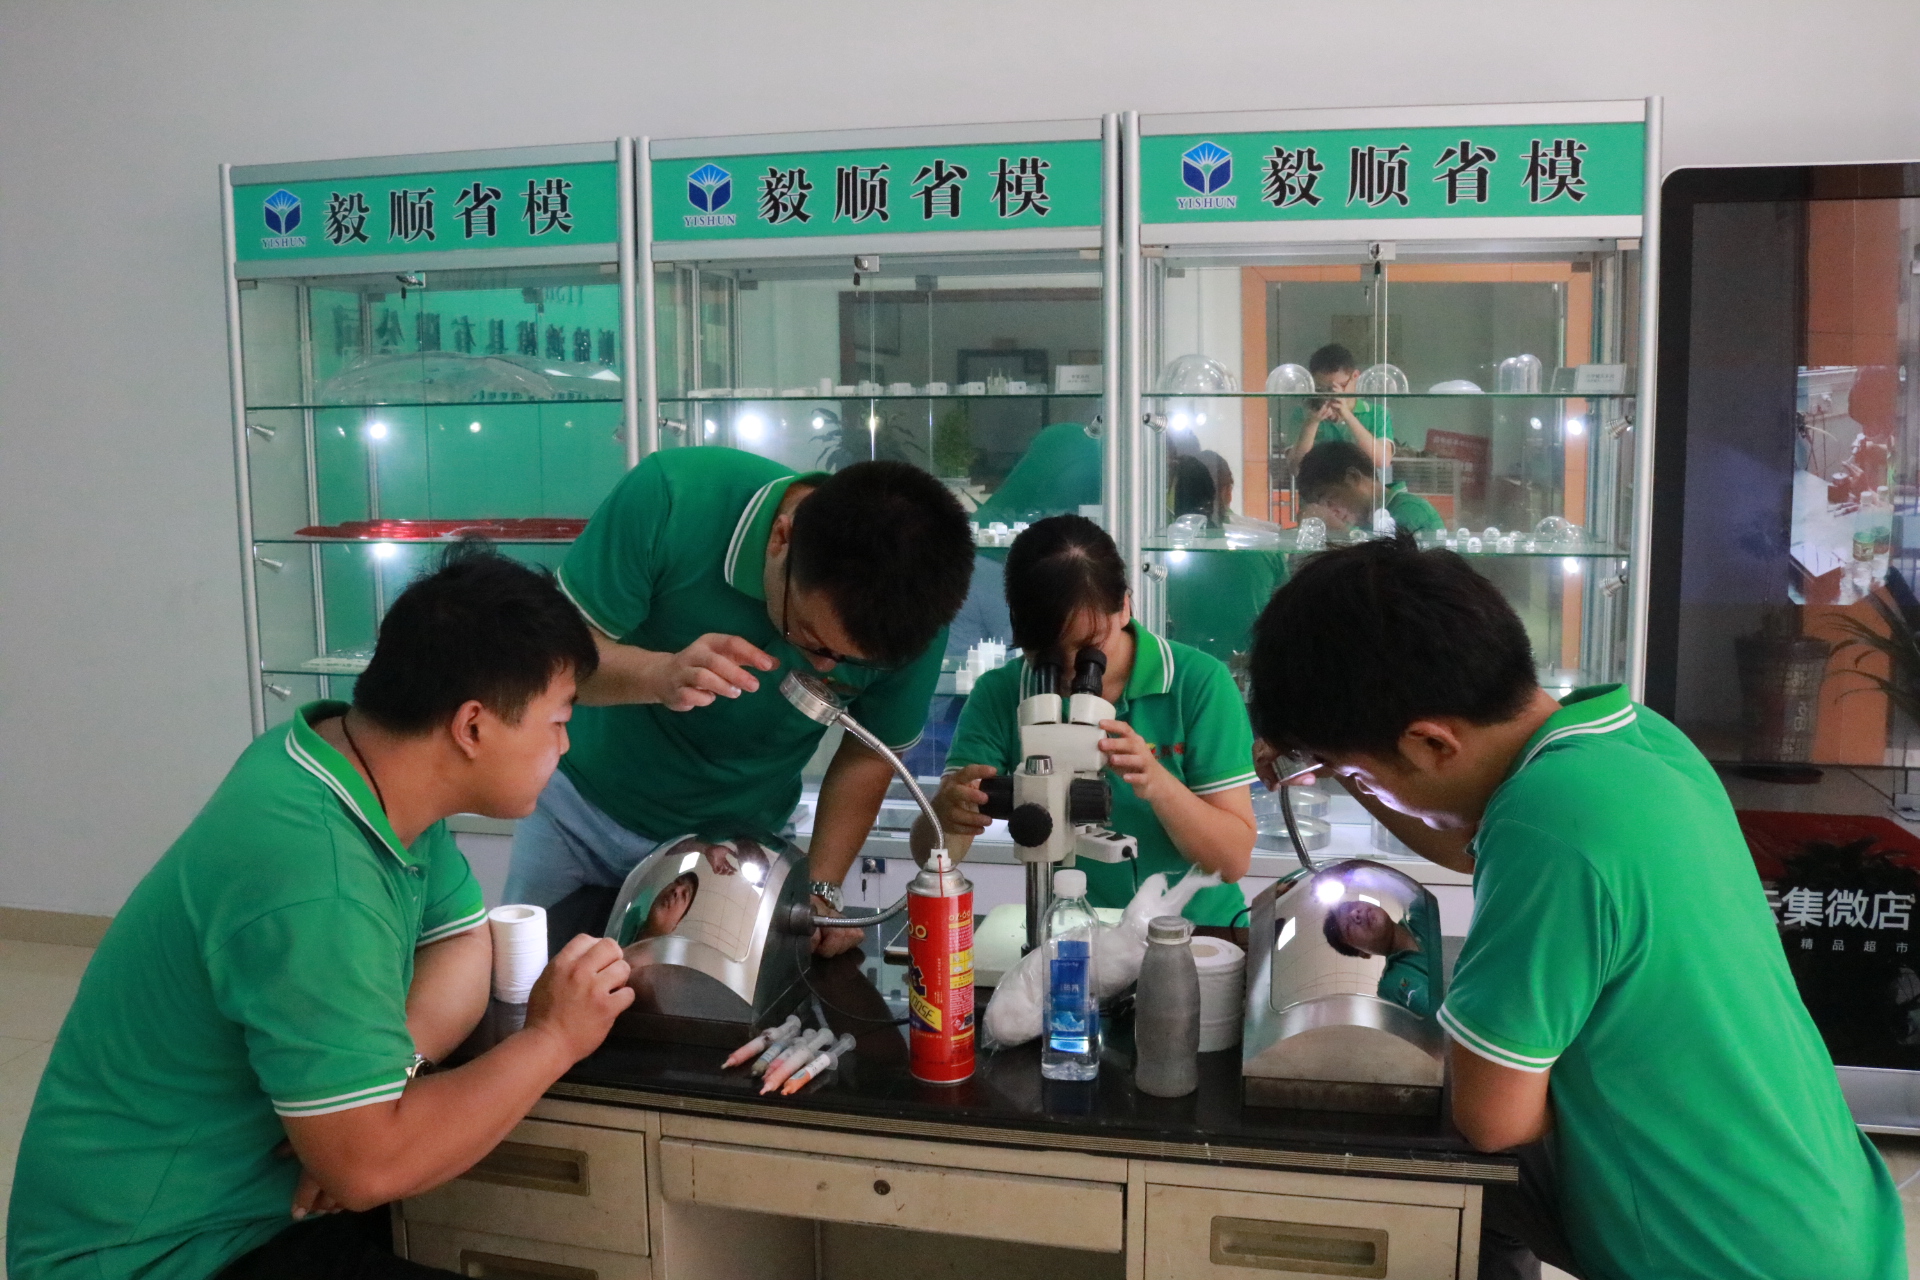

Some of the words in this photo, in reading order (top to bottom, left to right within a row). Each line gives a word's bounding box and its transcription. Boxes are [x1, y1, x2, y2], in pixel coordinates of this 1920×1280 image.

[1261, 139, 1589, 208] 毅顺省模
[758, 156, 1051, 225] 毅顺省模
[1177, 196, 1237, 209] YISHUN
[323, 177, 574, 245] 毅顺省模
[684, 214, 736, 227] YISHUN
[261, 236, 306, 249] YISHUN
[1801, 937, 1909, 953] 精品超市
